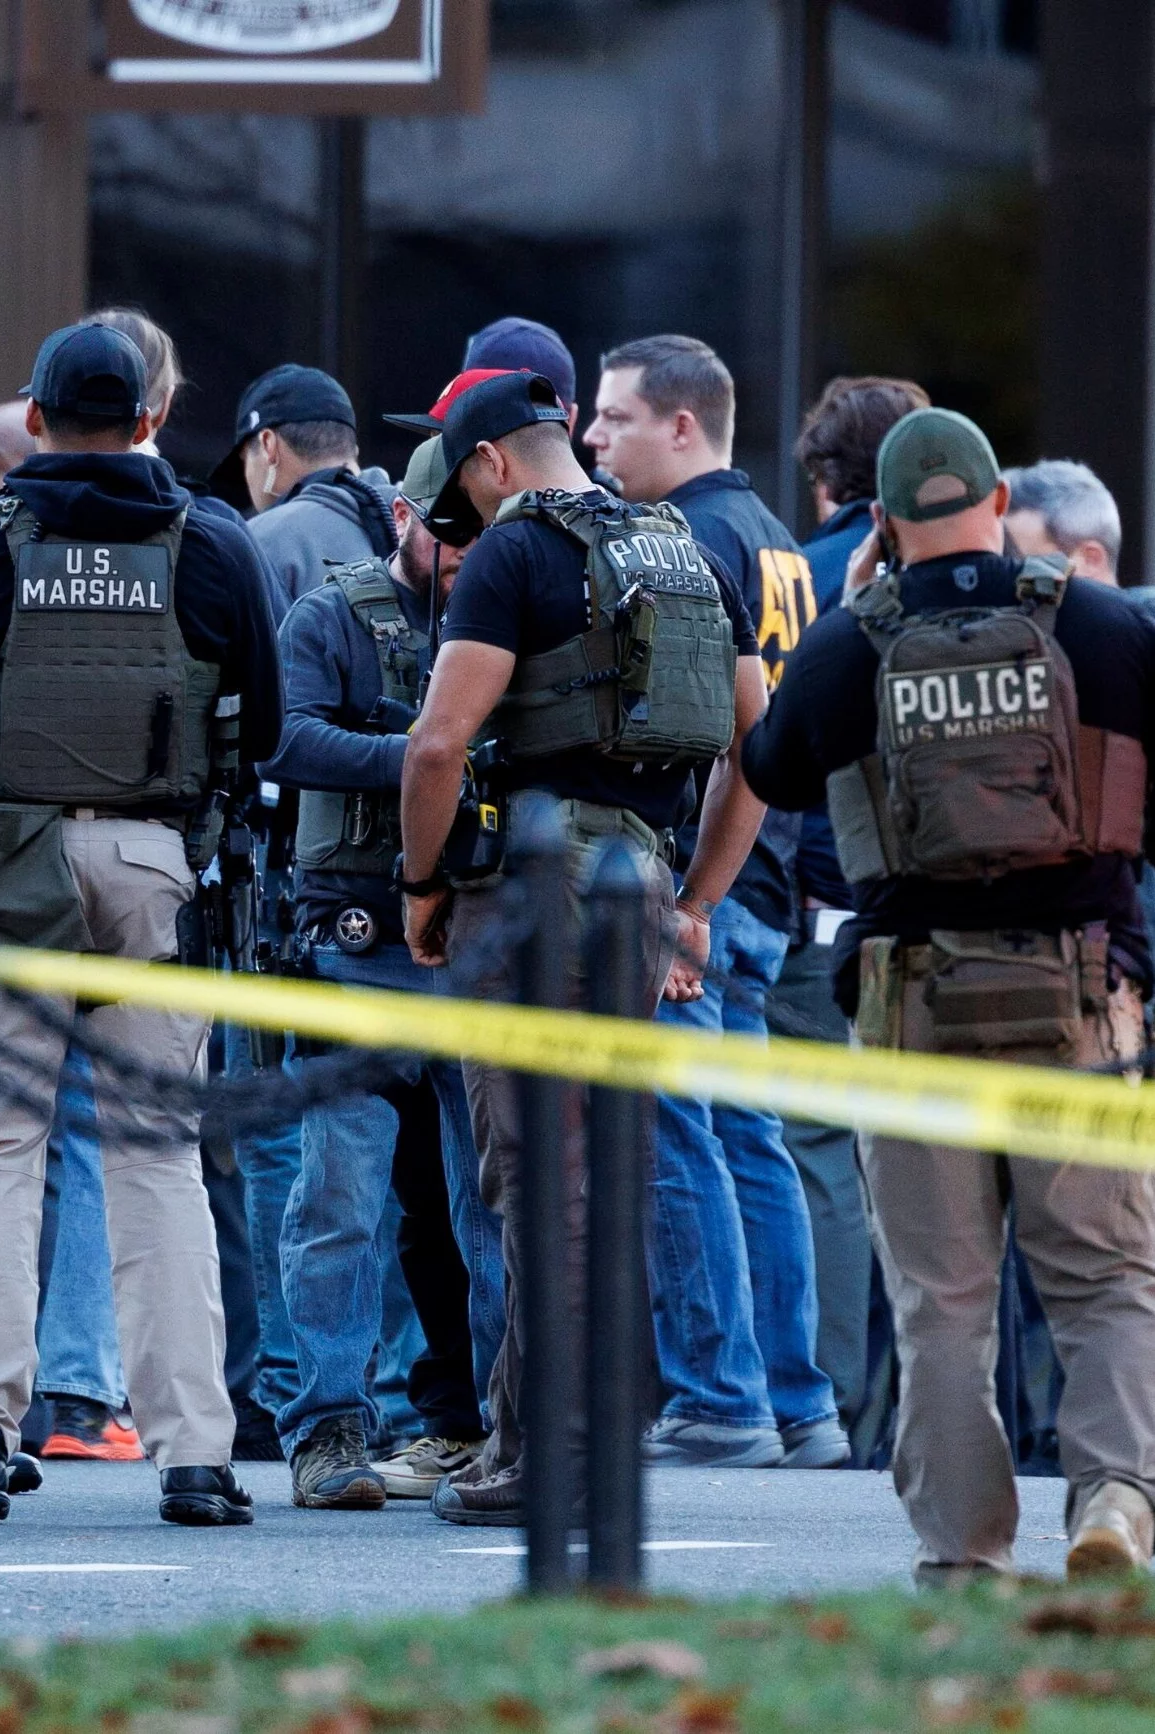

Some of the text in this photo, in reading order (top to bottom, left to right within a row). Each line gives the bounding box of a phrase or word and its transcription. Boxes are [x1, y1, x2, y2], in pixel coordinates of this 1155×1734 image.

[66, 548, 118, 575] U.S.
[22, 578, 163, 608] MARSHAL
[655, 572, 718, 597] MARSHAL
[894, 664, 1049, 725] POLICE
[944, 713, 1049, 740] MARSHAL
